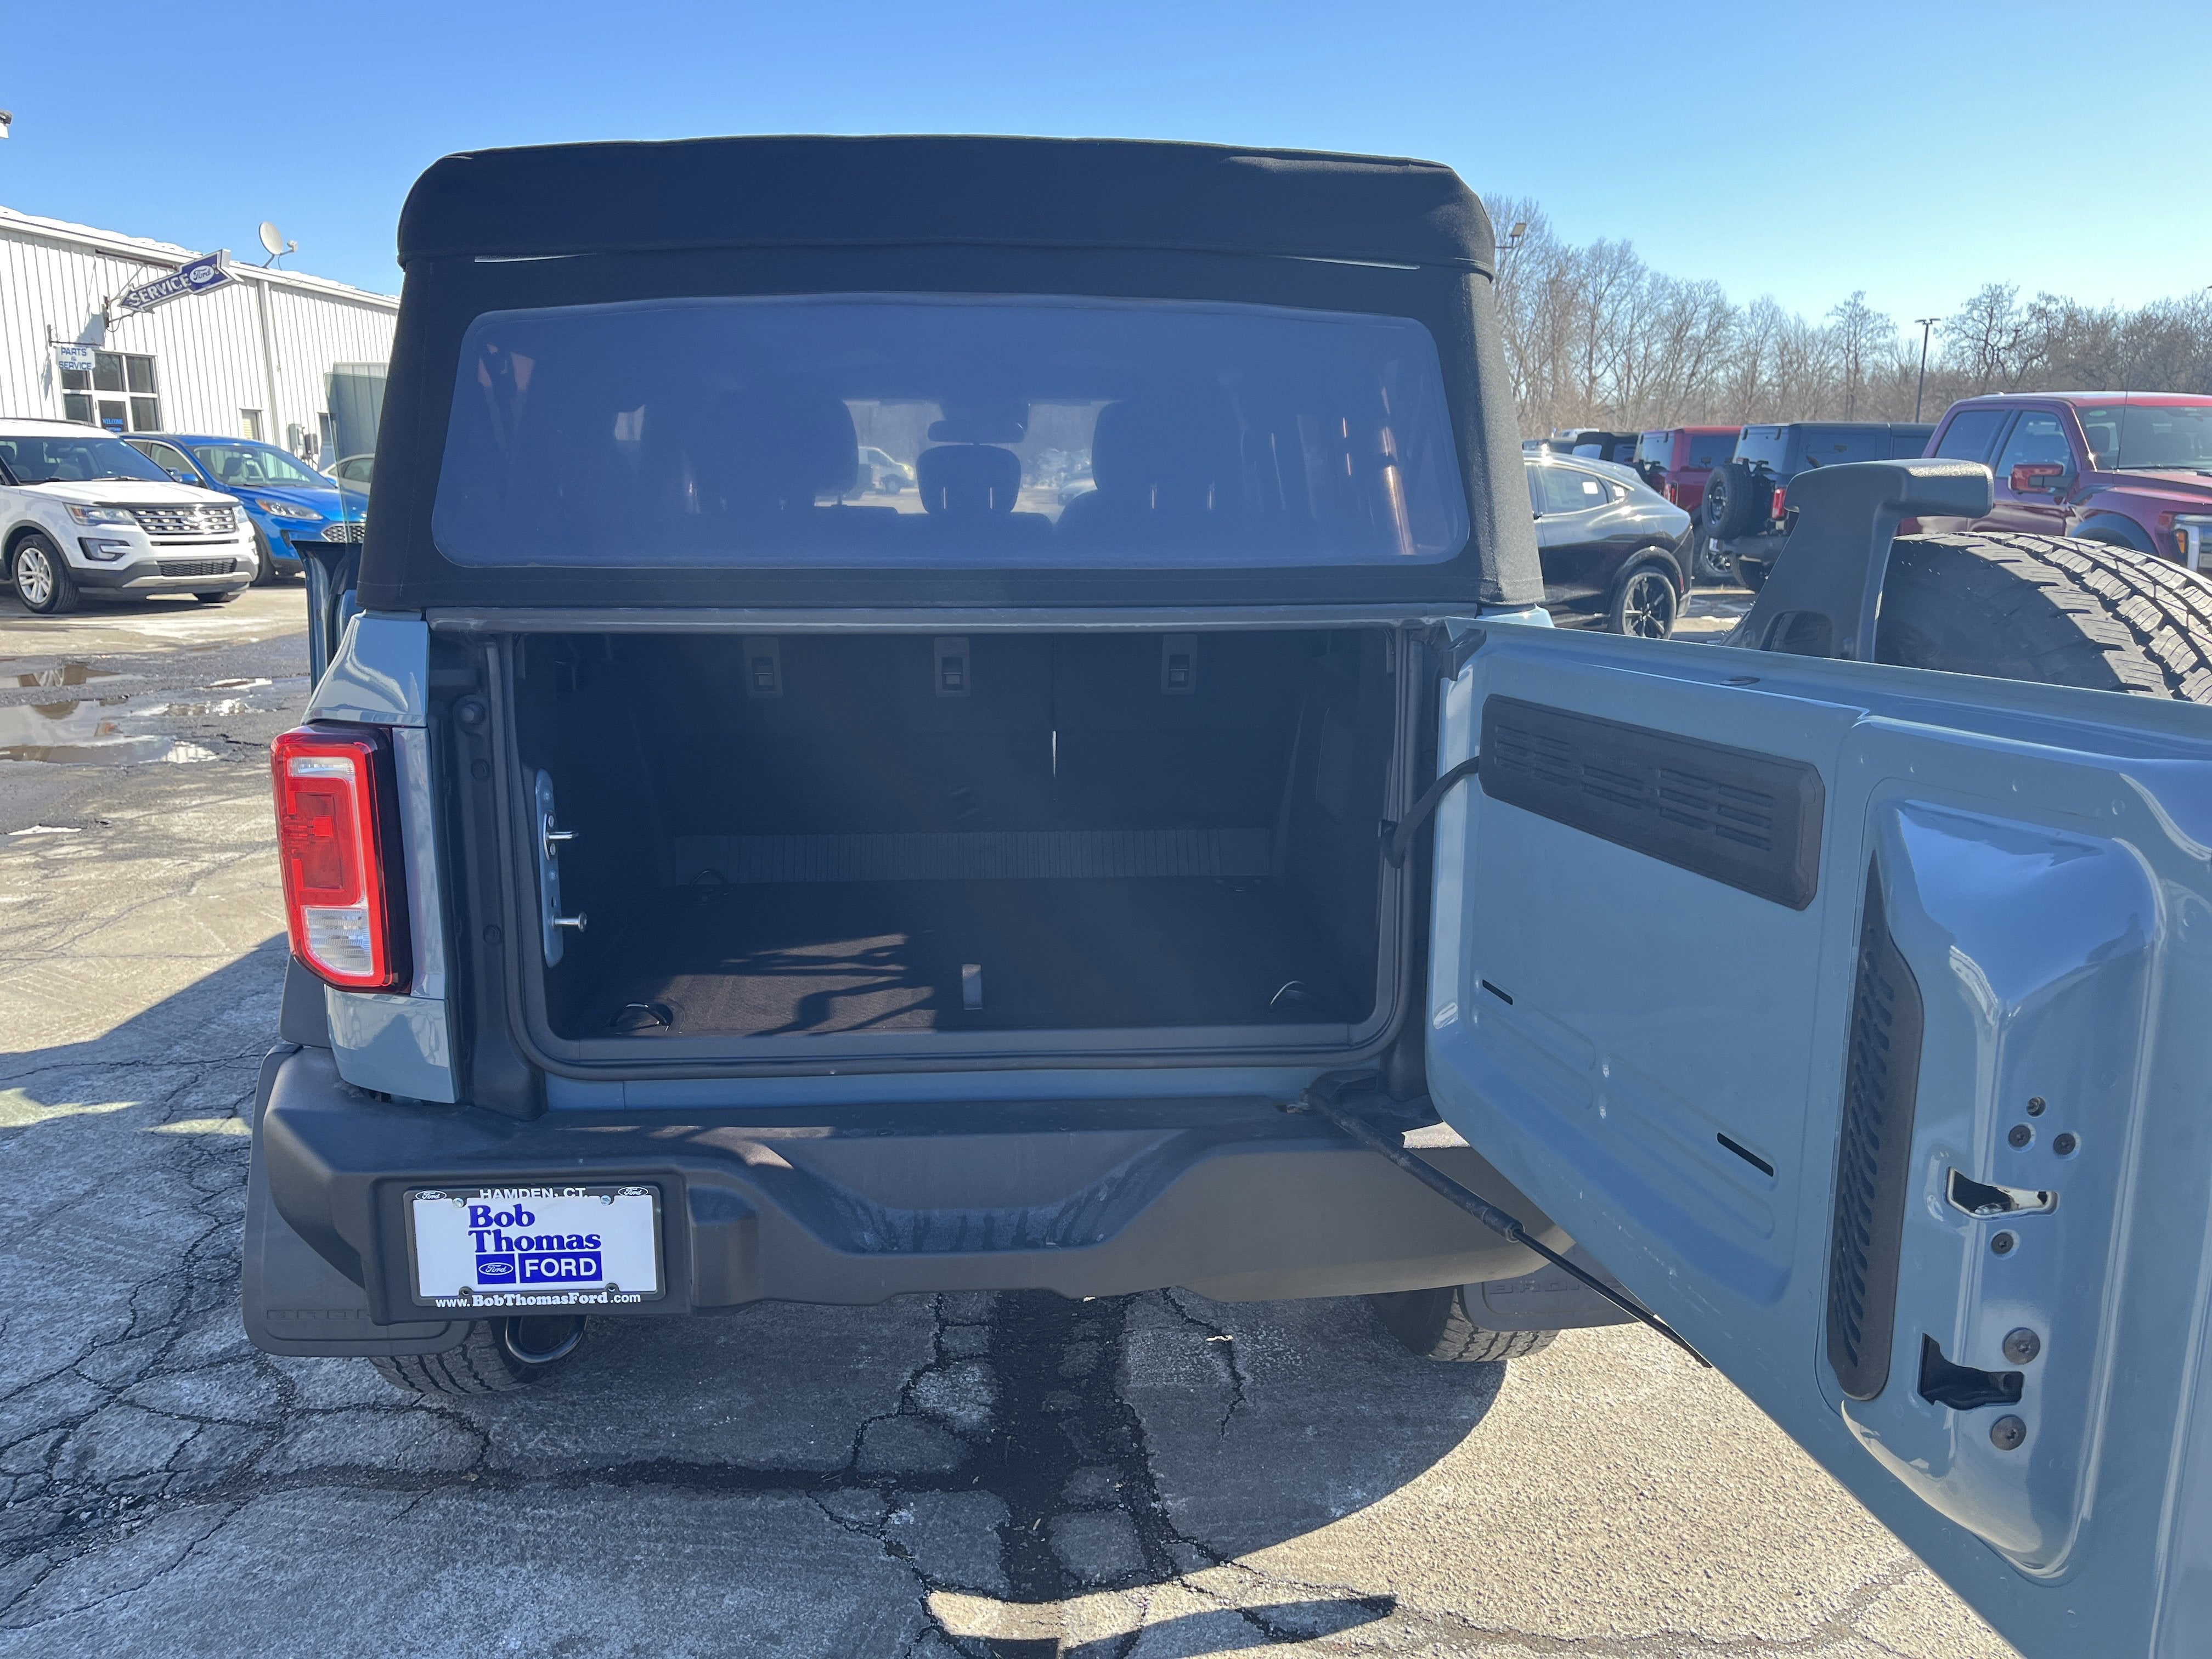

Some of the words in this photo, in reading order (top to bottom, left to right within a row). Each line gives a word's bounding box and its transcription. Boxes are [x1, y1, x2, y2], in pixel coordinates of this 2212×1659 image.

[128, 273, 192, 306] SERVICE
[193, 267, 213, 280] Ford
[61, 347, 87, 356] PARTS
[58, 361, 92, 370] SERVICE
[420, 1190, 441, 1200] Ford
[467, 1204, 535, 1228] Bob
[467, 1229, 602, 1253] Thomas
[484, 1263, 507, 1273] Ford
[524, 1258, 597, 1278] FORD
[435, 1291, 641, 1307] www.BobThomasFord.com
